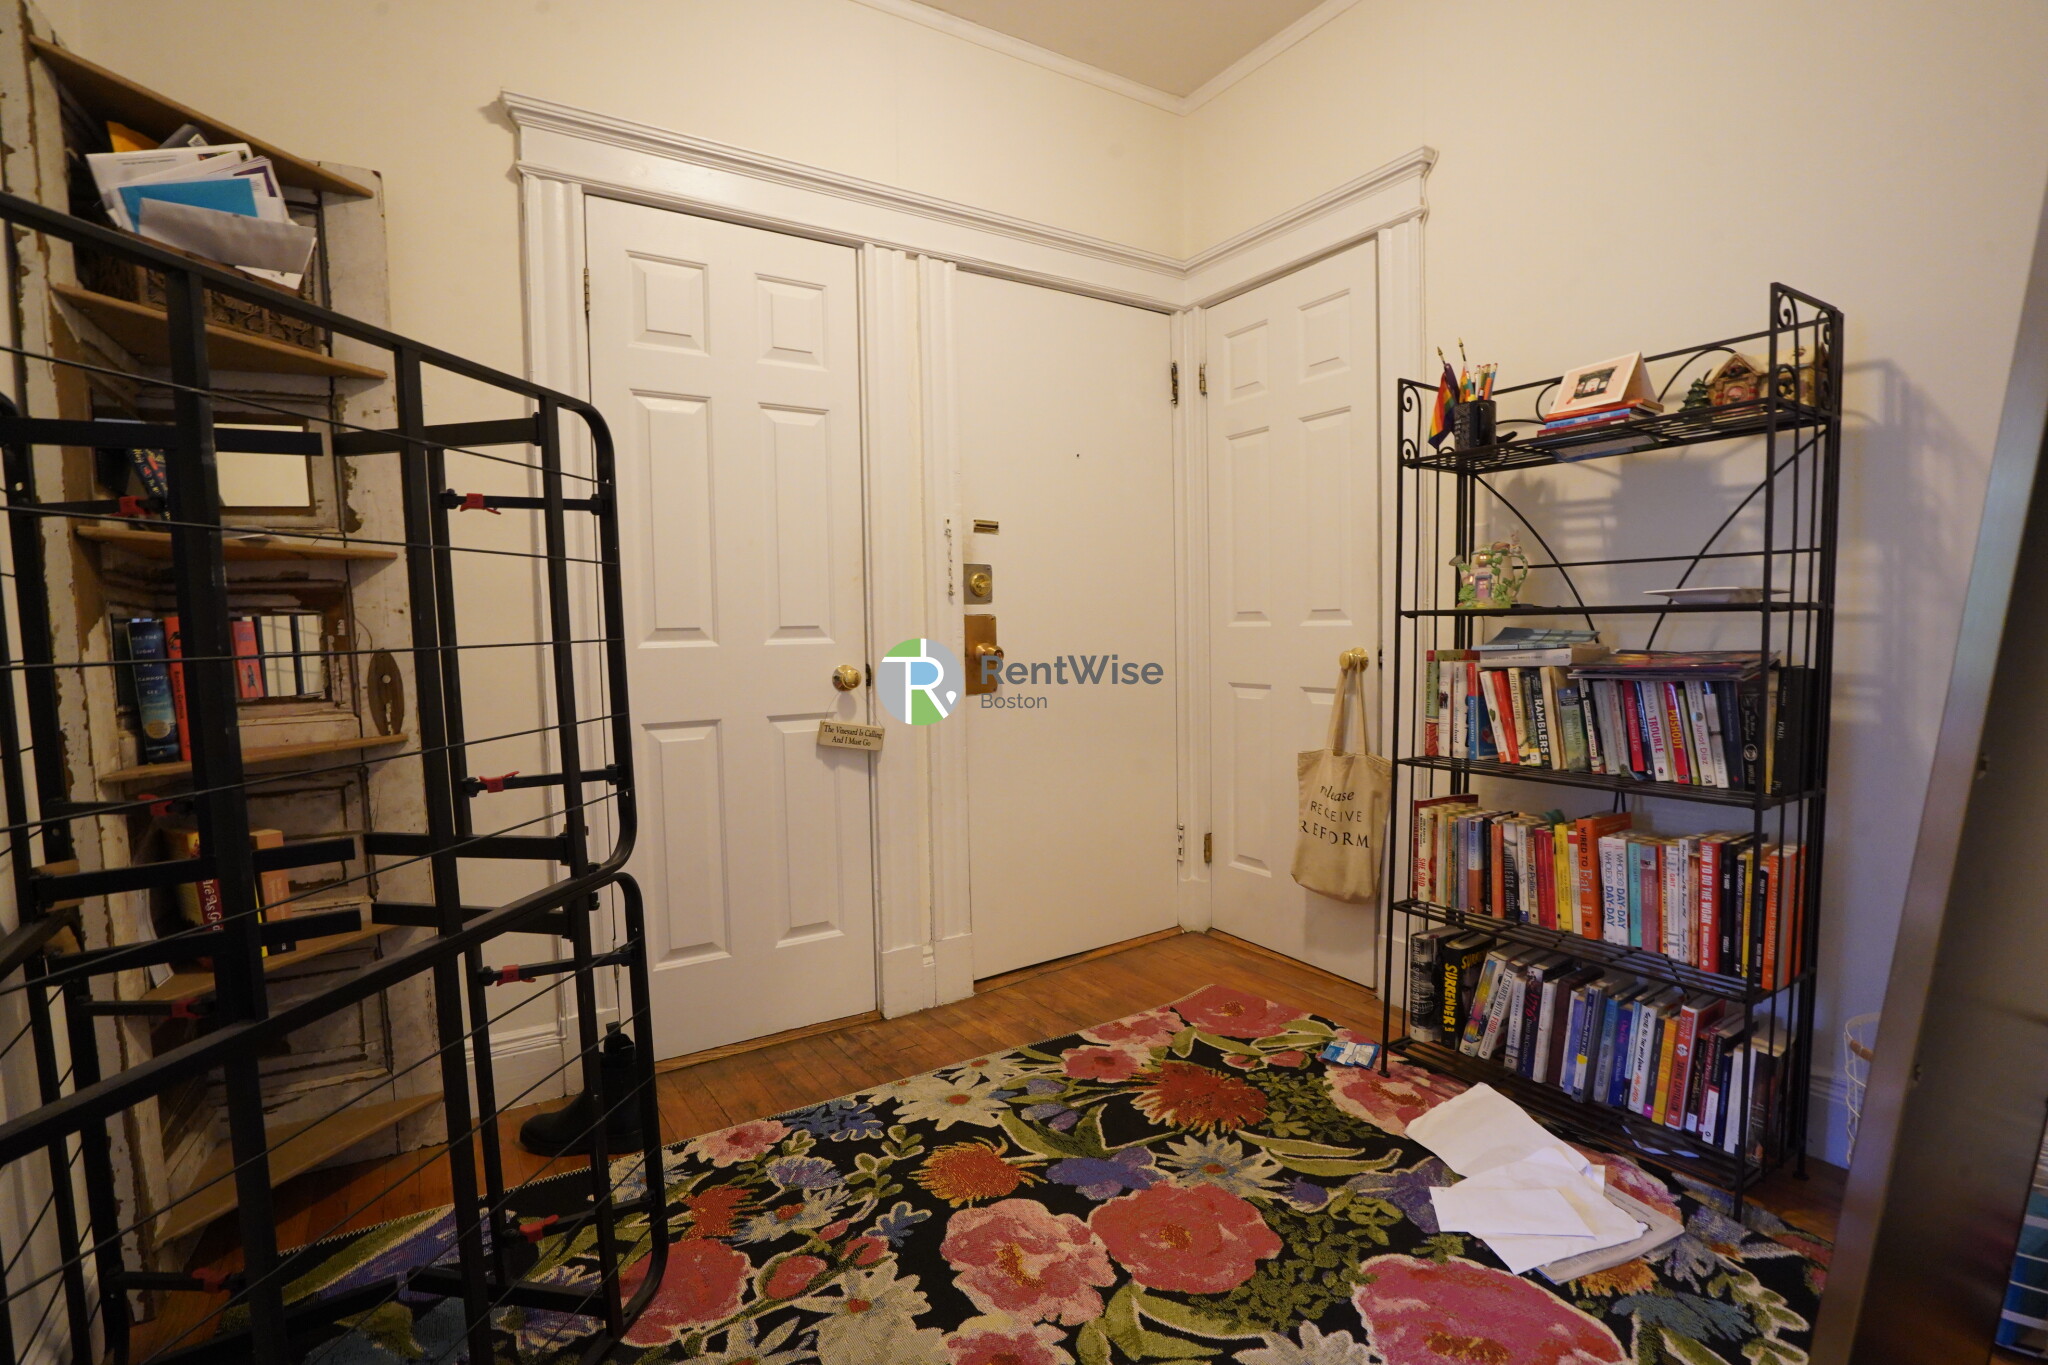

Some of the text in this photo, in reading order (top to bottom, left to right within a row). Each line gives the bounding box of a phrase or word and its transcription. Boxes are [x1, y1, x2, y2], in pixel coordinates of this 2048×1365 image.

[137, 675, 164, 683] CANNOT
[824, 725, 834, 733] The
[836, 726, 858, 736] Vineyard
[864, 730, 882, 740] Calling
[1535, 699, 1549, 754] RAMBLERS
[1629, 709, 1638, 740] Intellectual
[1648, 716, 1664, 753] TROUBLE
[1668, 710, 1683, 750] PUSHOUT
[1695, 724, 1706, 746] Junot
[1311, 800, 1362, 822] RECEIVE
[1300, 820, 1369, 848] REFORM
[1579, 827, 1593, 895] WIRED TO Eat
[1702, 845, 1712, 864] HOW
[1418, 858, 1426, 887] SHE SAID
[1702, 864, 1712, 874] TO
[1702, 875, 1712, 886] DO
[1605, 851, 1615, 927] WHOLE30 DAY DAY
[1616, 853, 1626, 930] WHOLE30 DAY DAY
[1702, 887, 1712, 902] THE
[1770, 882, 1778, 918] STARTER
[1701, 902, 1712, 925] WORK
[1412, 941, 1421, 965] BRUCE
[1767, 920, 1776, 960] SESSIONS
[1412, 967, 1420, 1014] SPRINGSTEEN
[1443, 963, 1458, 1025] SURRENDER
[1498, 979, 1511, 1001] STARTS
[1493, 1000, 1504, 1017] WITH
[1524, 993, 1541, 1022] 1776
[1488, 1016, 1499, 1034] FOOD
[1675, 1061, 1685, 1080] SAVING
[1670, 1080, 1683, 1112] CAPITALISM
